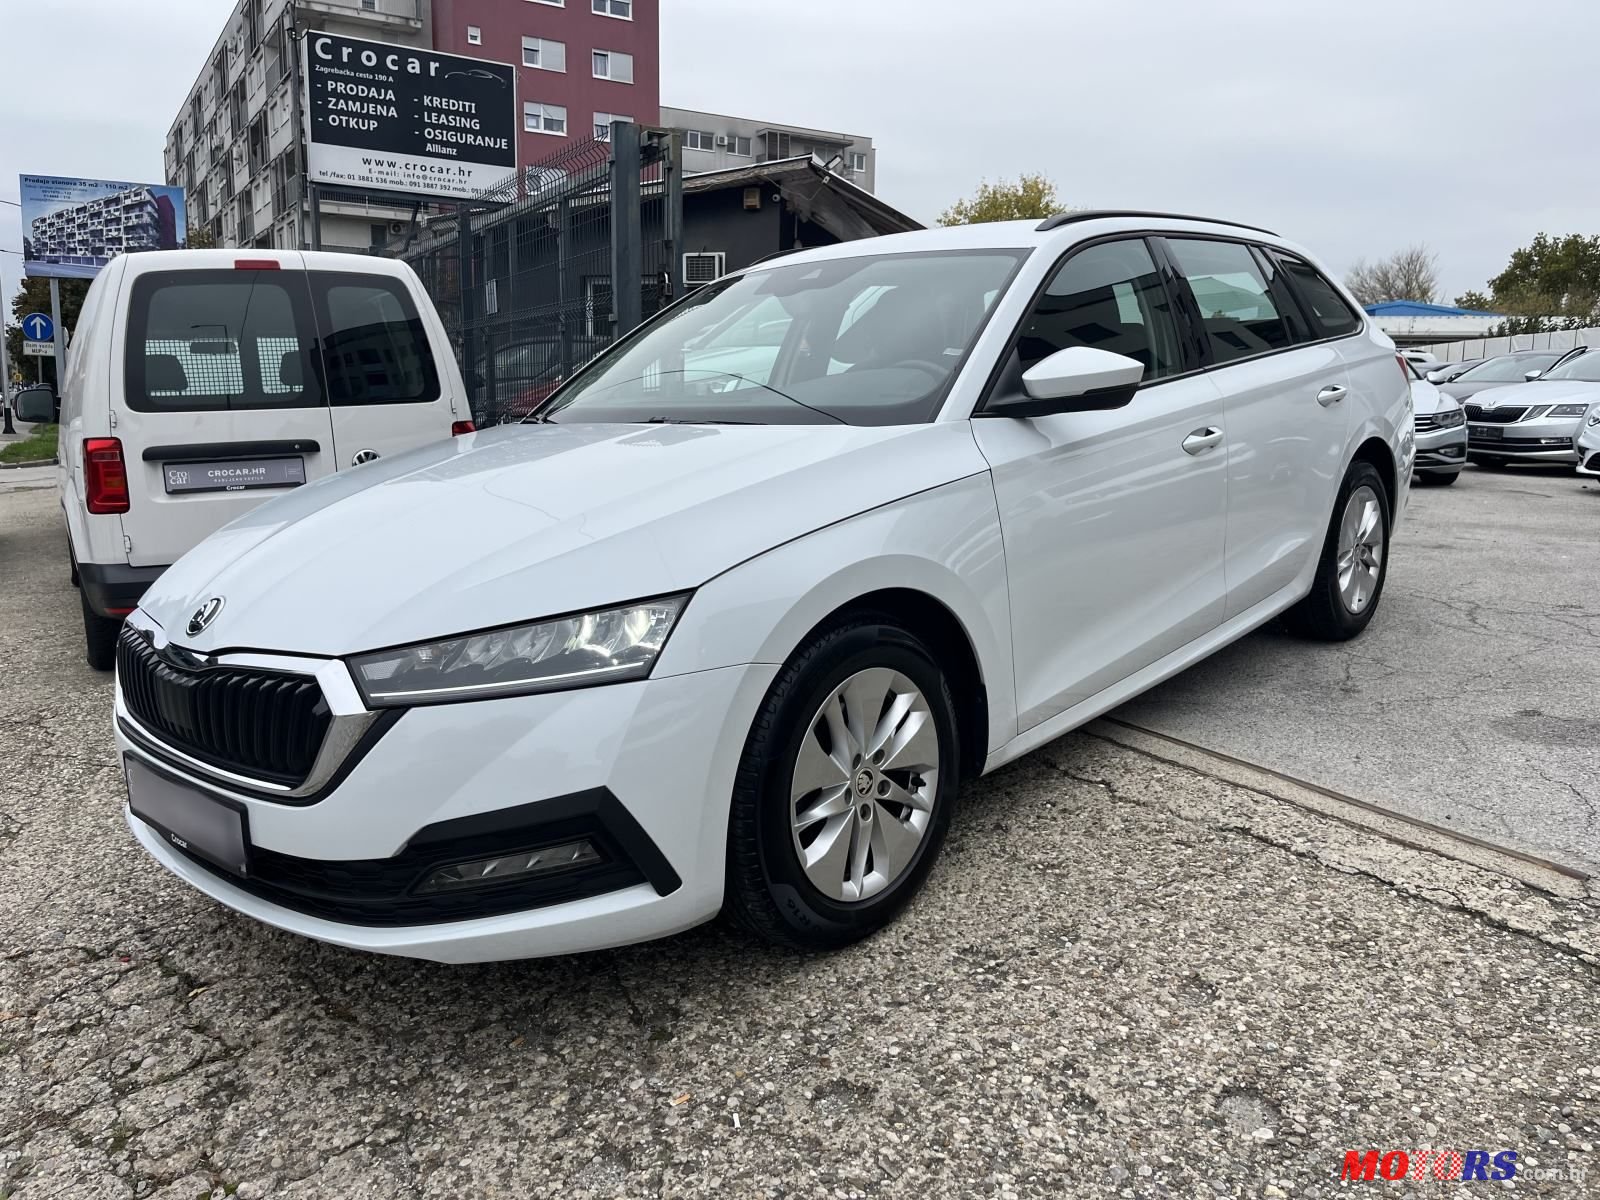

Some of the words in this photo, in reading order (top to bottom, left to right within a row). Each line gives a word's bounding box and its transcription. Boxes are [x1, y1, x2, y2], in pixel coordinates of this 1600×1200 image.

[315, 37, 440, 76] Crocar
[327, 80, 396, 101] PRODAJA
[328, 97, 398, 118] ZAMJENA
[423, 95, 476, 114] KREDITI
[328, 114, 378, 131] OTKUP
[424, 111, 480, 130] LEASING
[424, 127, 509, 150] OSIGURANJE
[425, 143, 458, 155] Allianz
[362, 157, 473, 177] www.crocar.hr
[358, 175, 373, 183] 3881
[389, 179, 408, 187] mob.:
[409, 180, 421, 188] 091
[403, 172, 468, 185] info@crocar.hr
[169, 470, 188, 478] Cro
[170, 476, 188, 485] car
[207, 467, 266, 478] CROCAR.HR
